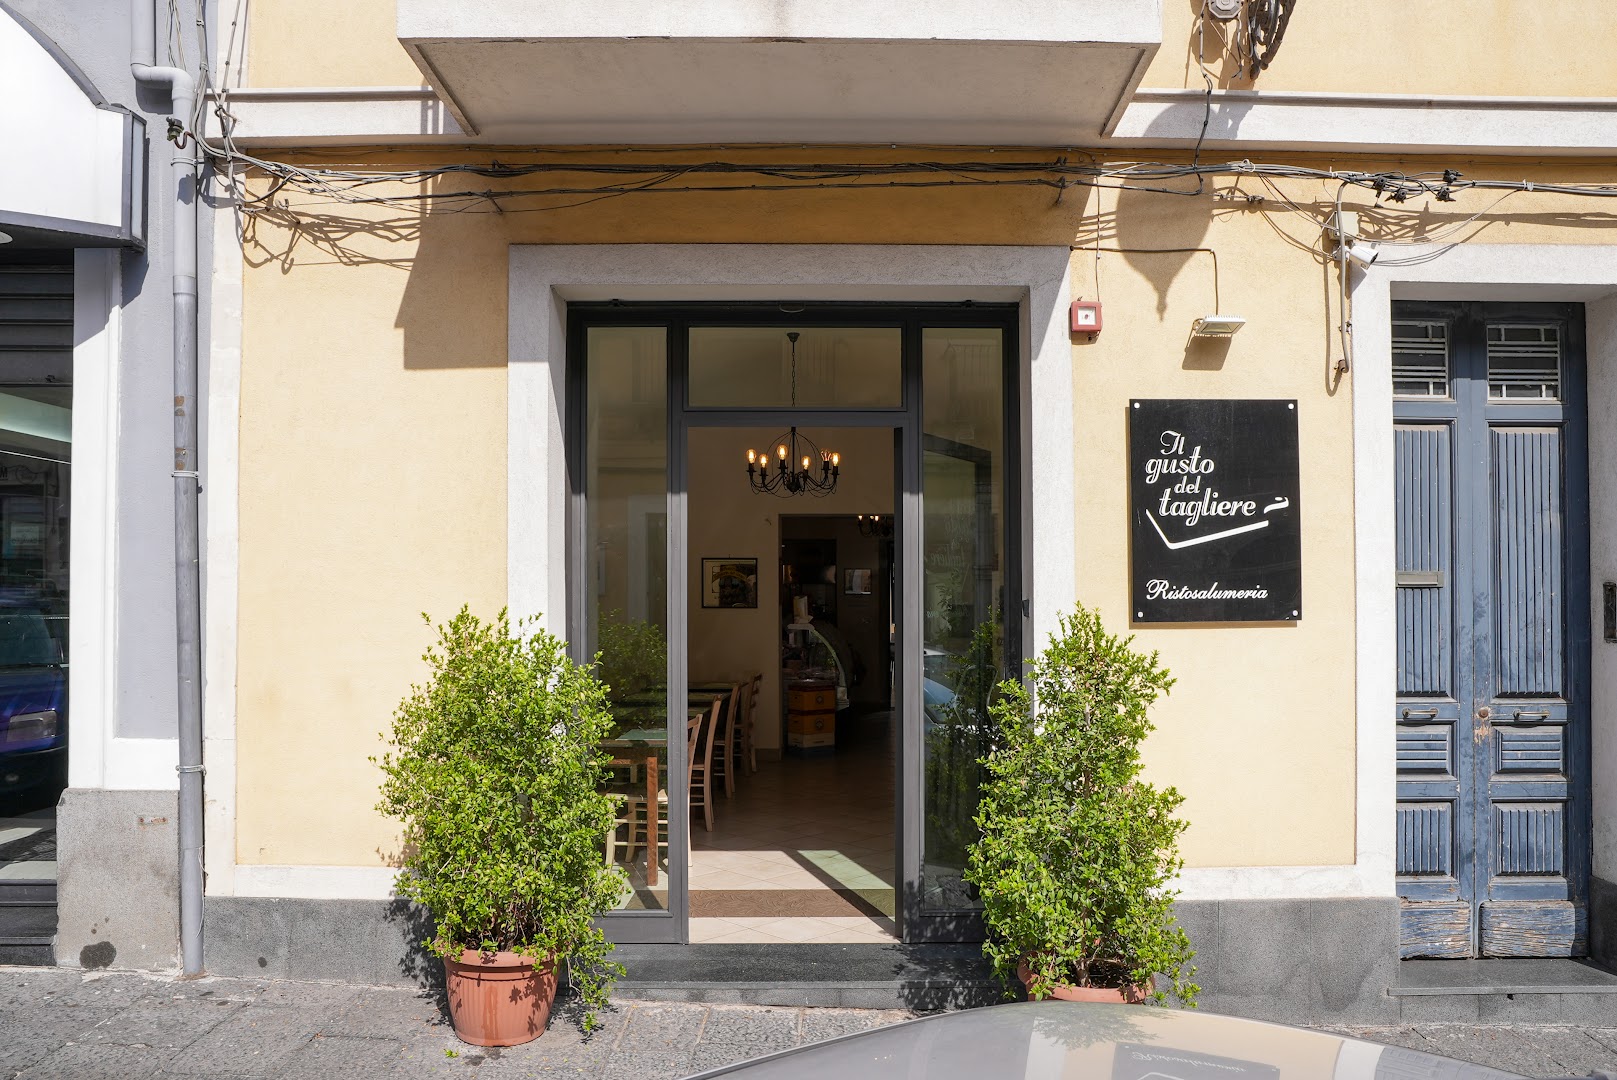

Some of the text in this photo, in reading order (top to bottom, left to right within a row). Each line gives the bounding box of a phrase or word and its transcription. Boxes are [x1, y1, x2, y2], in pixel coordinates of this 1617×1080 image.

[1160, 430, 1186, 456] Il
[1145, 445, 1215, 485] gusto
[1173, 475, 1202, 494] del
[1158, 487, 1257, 527] tagliere
[1145, 578, 1269, 600] Ristosalumeria
